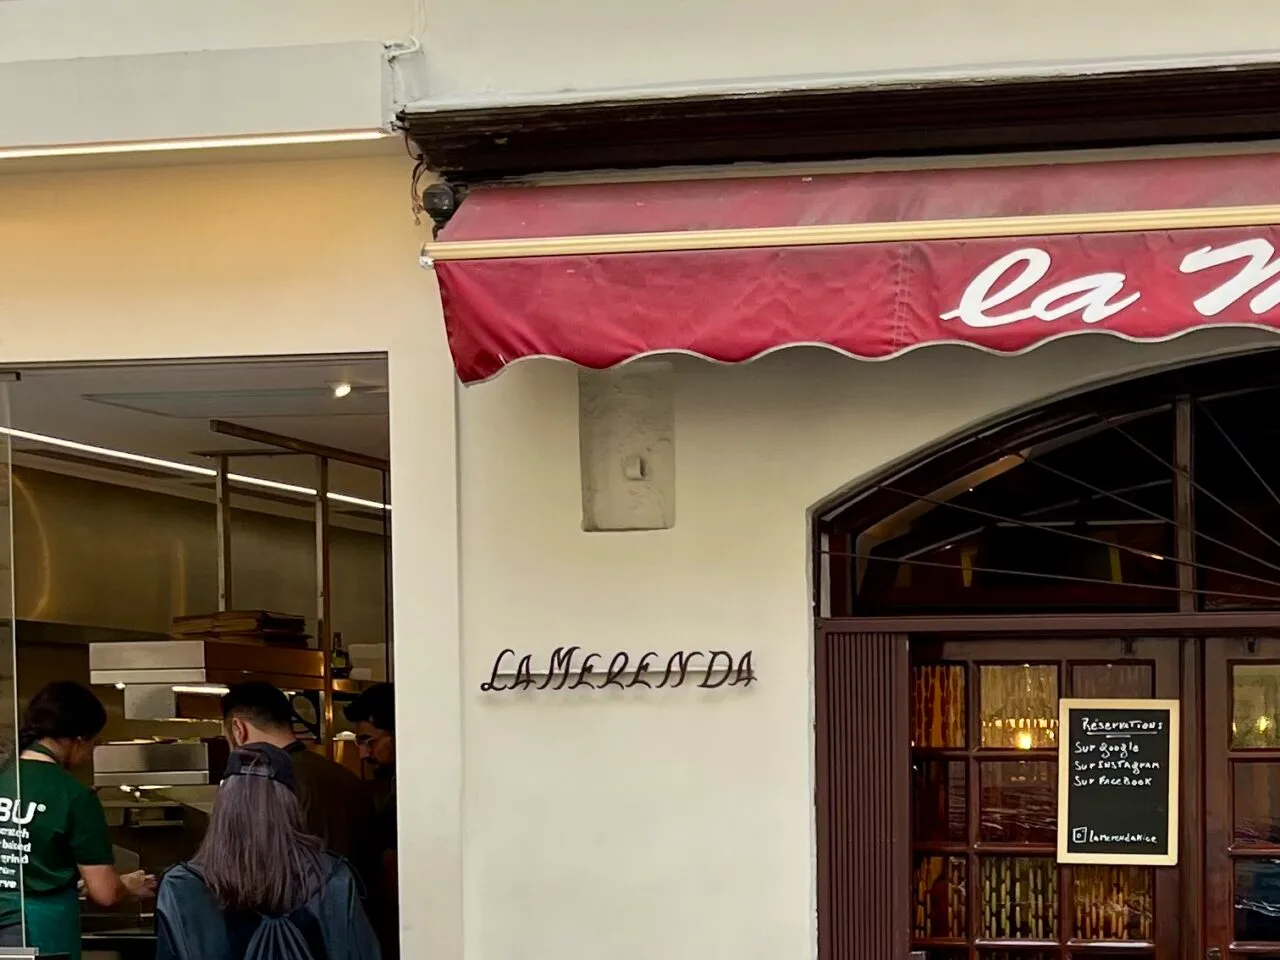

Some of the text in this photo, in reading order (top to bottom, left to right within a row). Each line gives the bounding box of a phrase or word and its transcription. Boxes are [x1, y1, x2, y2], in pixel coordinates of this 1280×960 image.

[940, 247, 1141, 327] la
[1074, 741, 1096, 753] Sur
[1074, 760, 1096, 770] Sur
[1074, 775, 1095, 786] Sur
